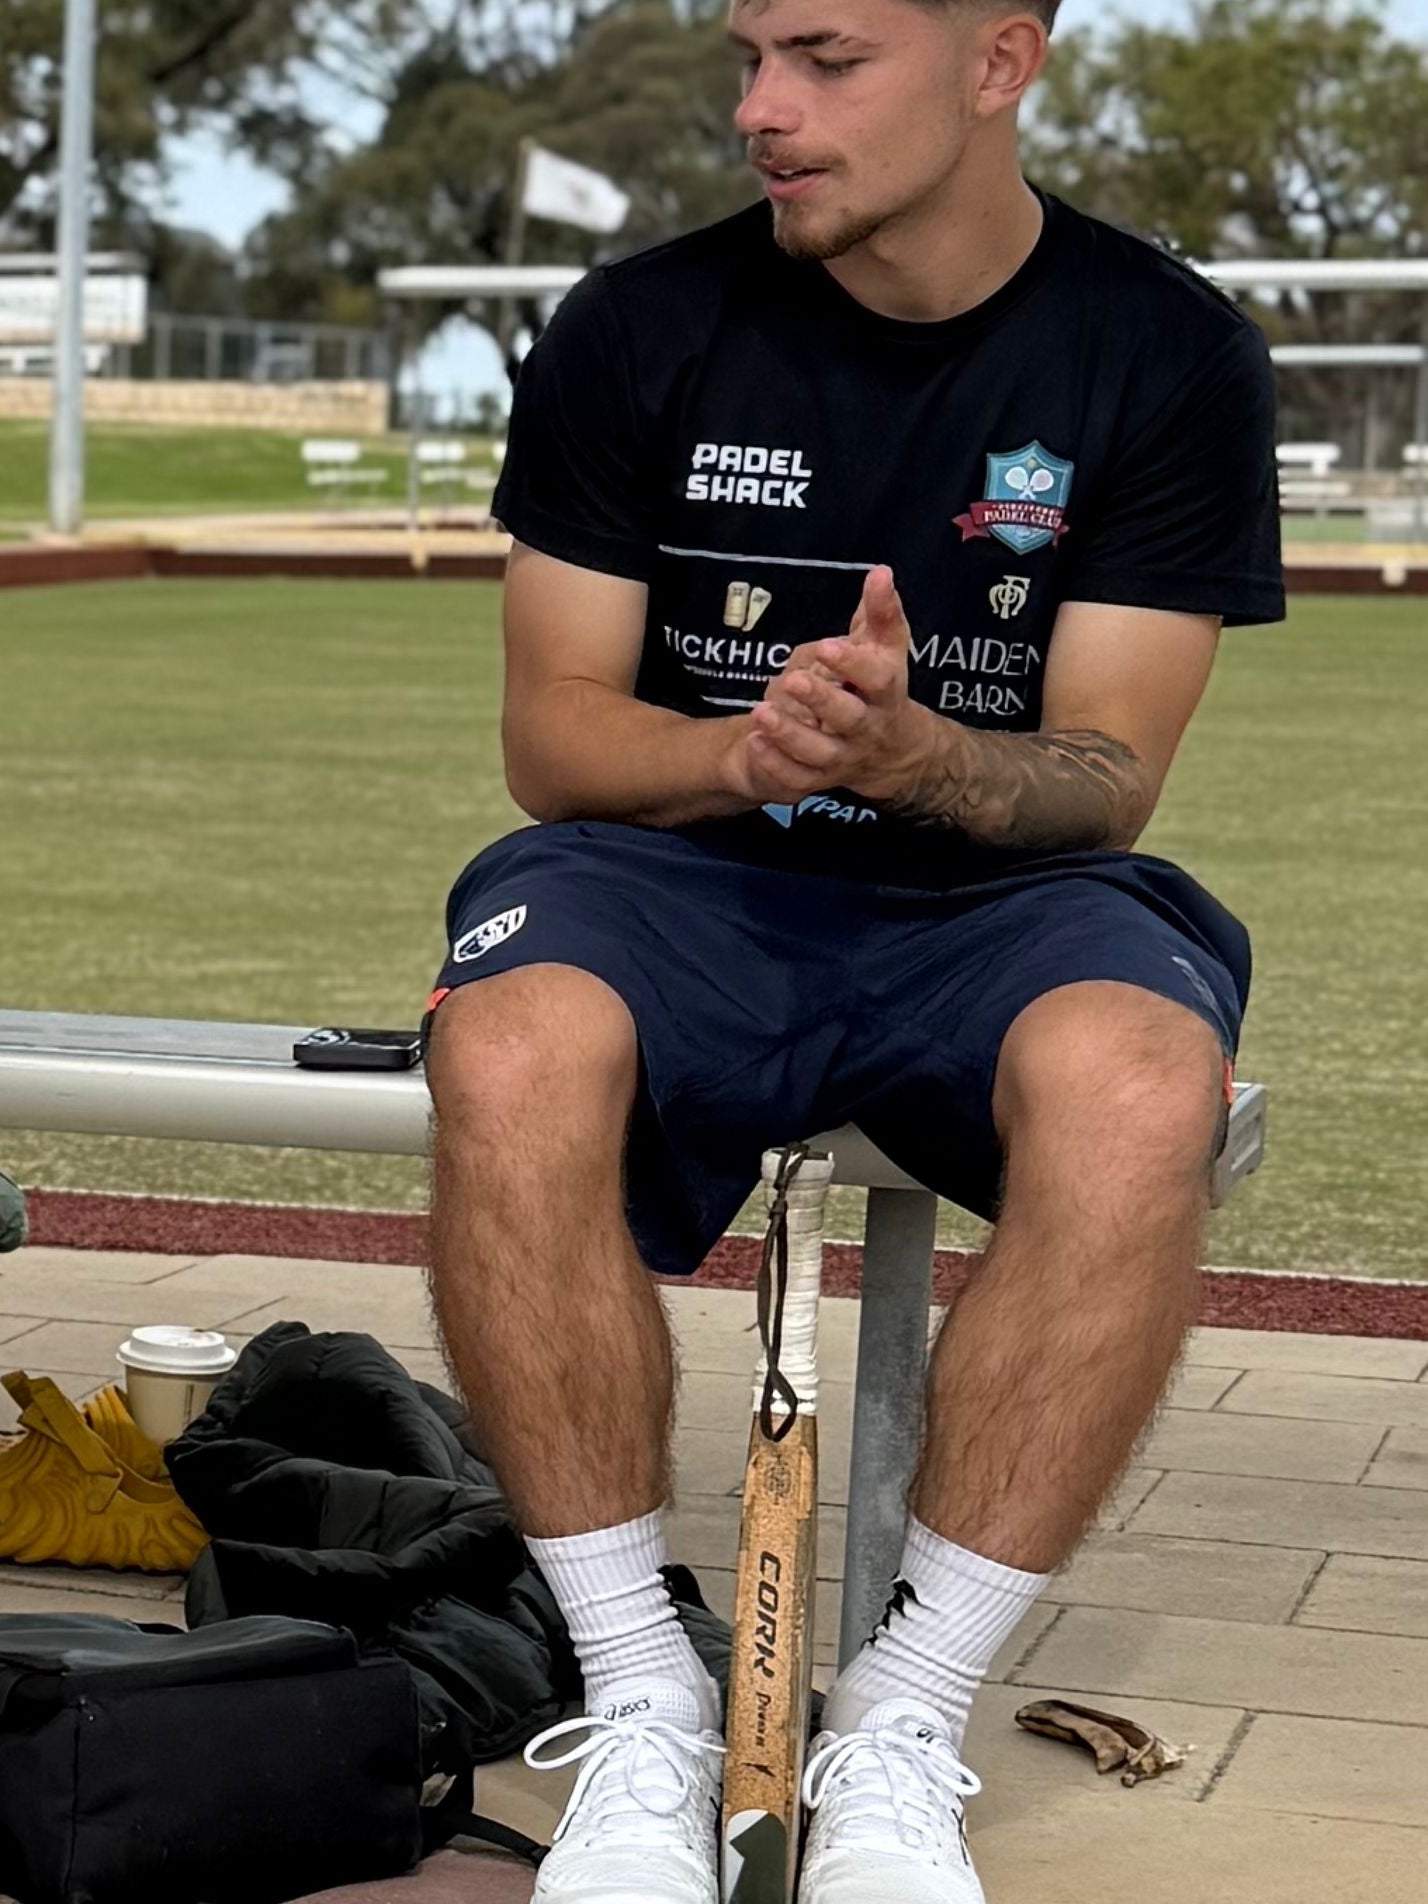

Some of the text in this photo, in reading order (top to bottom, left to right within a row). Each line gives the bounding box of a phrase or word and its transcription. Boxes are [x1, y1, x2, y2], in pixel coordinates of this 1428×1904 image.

[690, 442, 813, 478] PADEL
[685, 473, 811, 509] SHACK
[938, 680, 1028, 717] BARN
[754, 1550, 782, 1680] CORK
